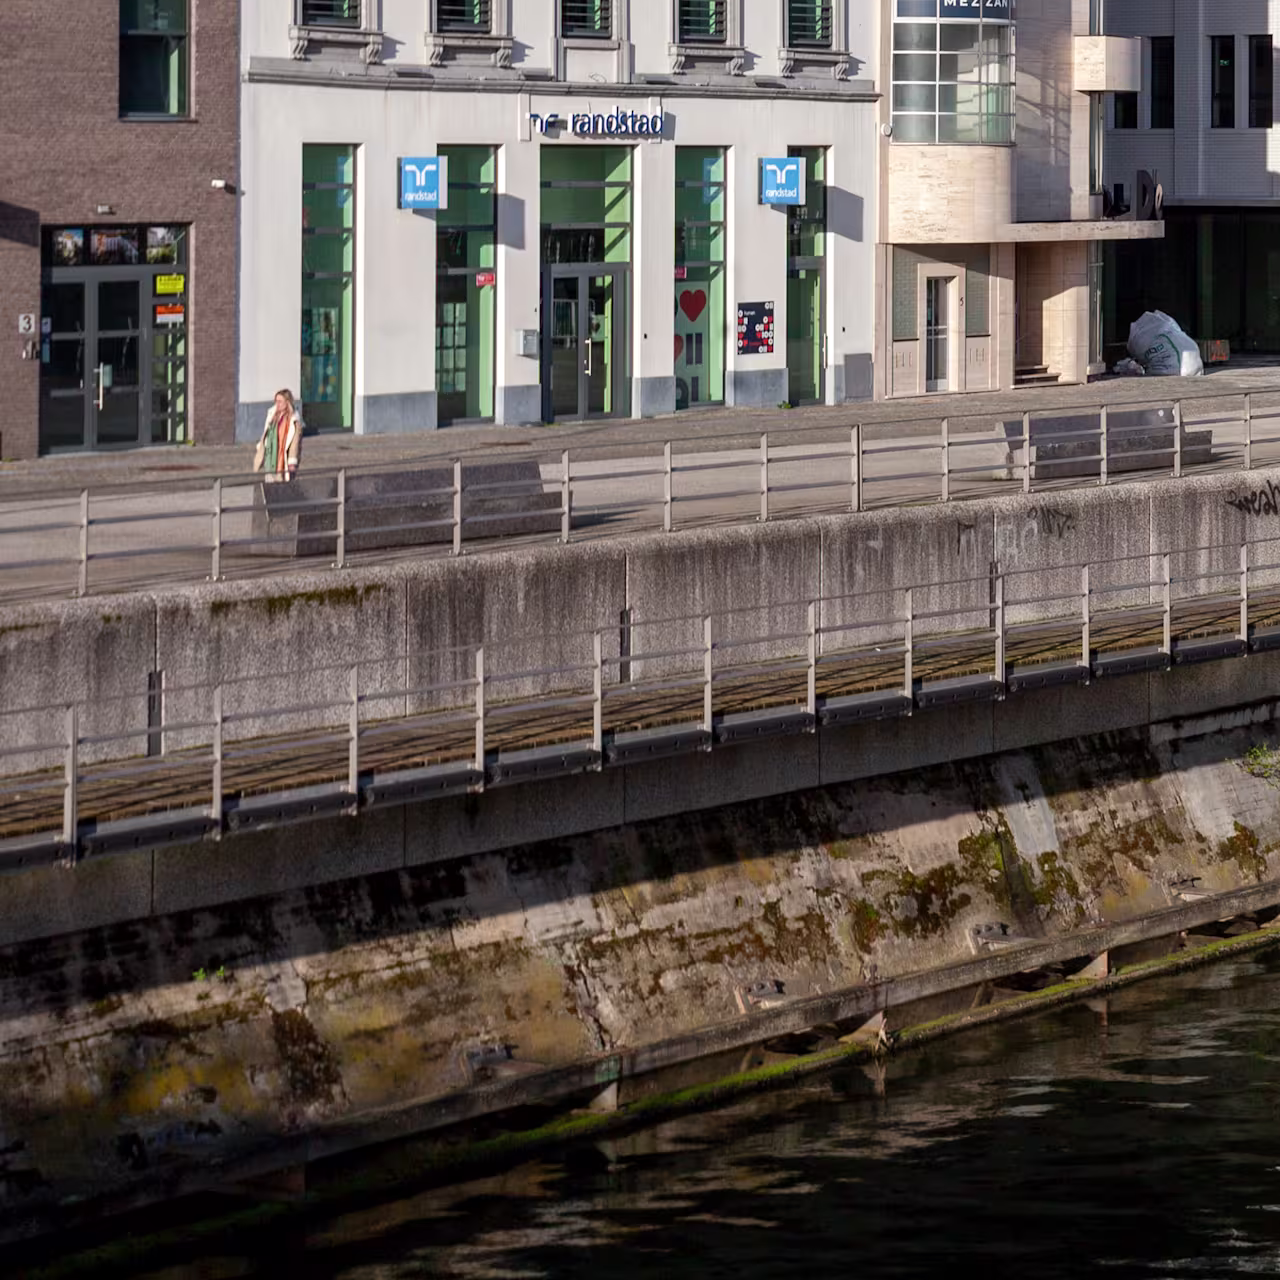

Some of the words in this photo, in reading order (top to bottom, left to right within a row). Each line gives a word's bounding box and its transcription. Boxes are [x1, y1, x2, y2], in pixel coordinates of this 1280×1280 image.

[568, 105, 663, 135] randstad
[404, 190, 437, 201] randstad
[765, 187, 797, 198] randstad
[23, 315, 32, 332] 3
